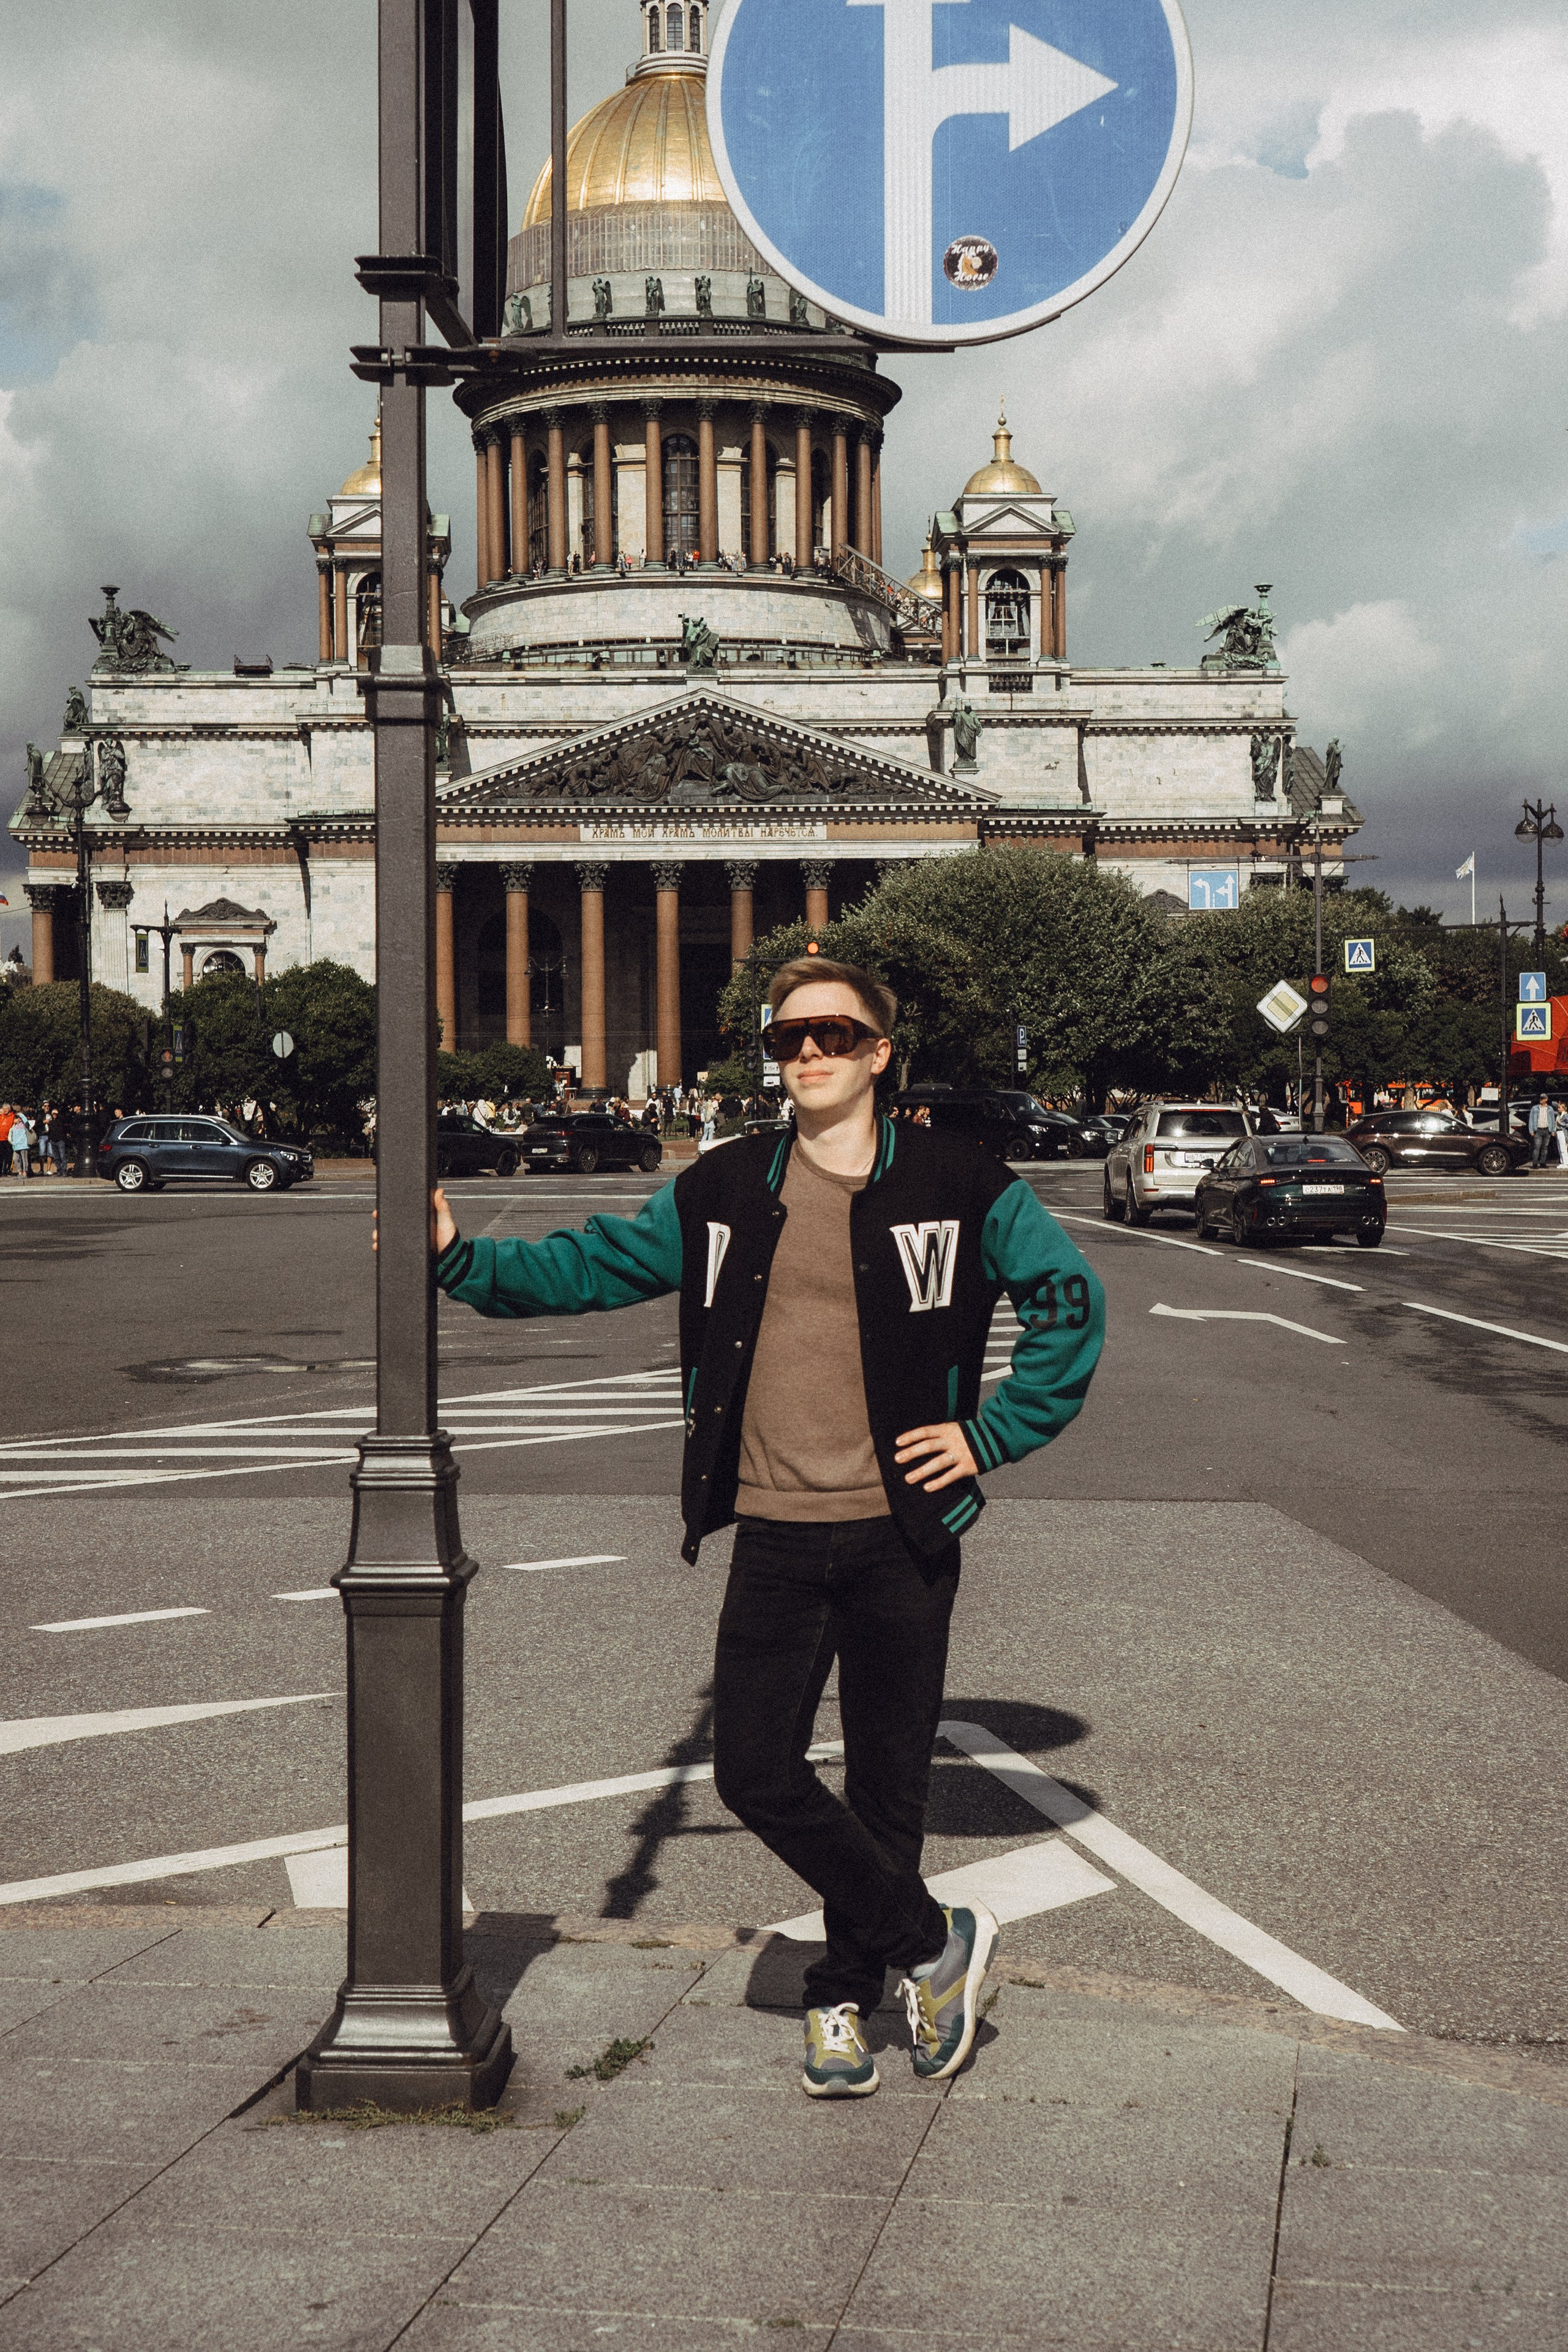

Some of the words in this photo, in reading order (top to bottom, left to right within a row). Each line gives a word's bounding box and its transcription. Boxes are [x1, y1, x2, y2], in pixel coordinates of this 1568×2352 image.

[951, 244, 990, 256] Happy
[954, 271, 989, 282] Horse
[889, 1220, 960, 1313] W
[1029, 1273, 1090, 1330] 99
